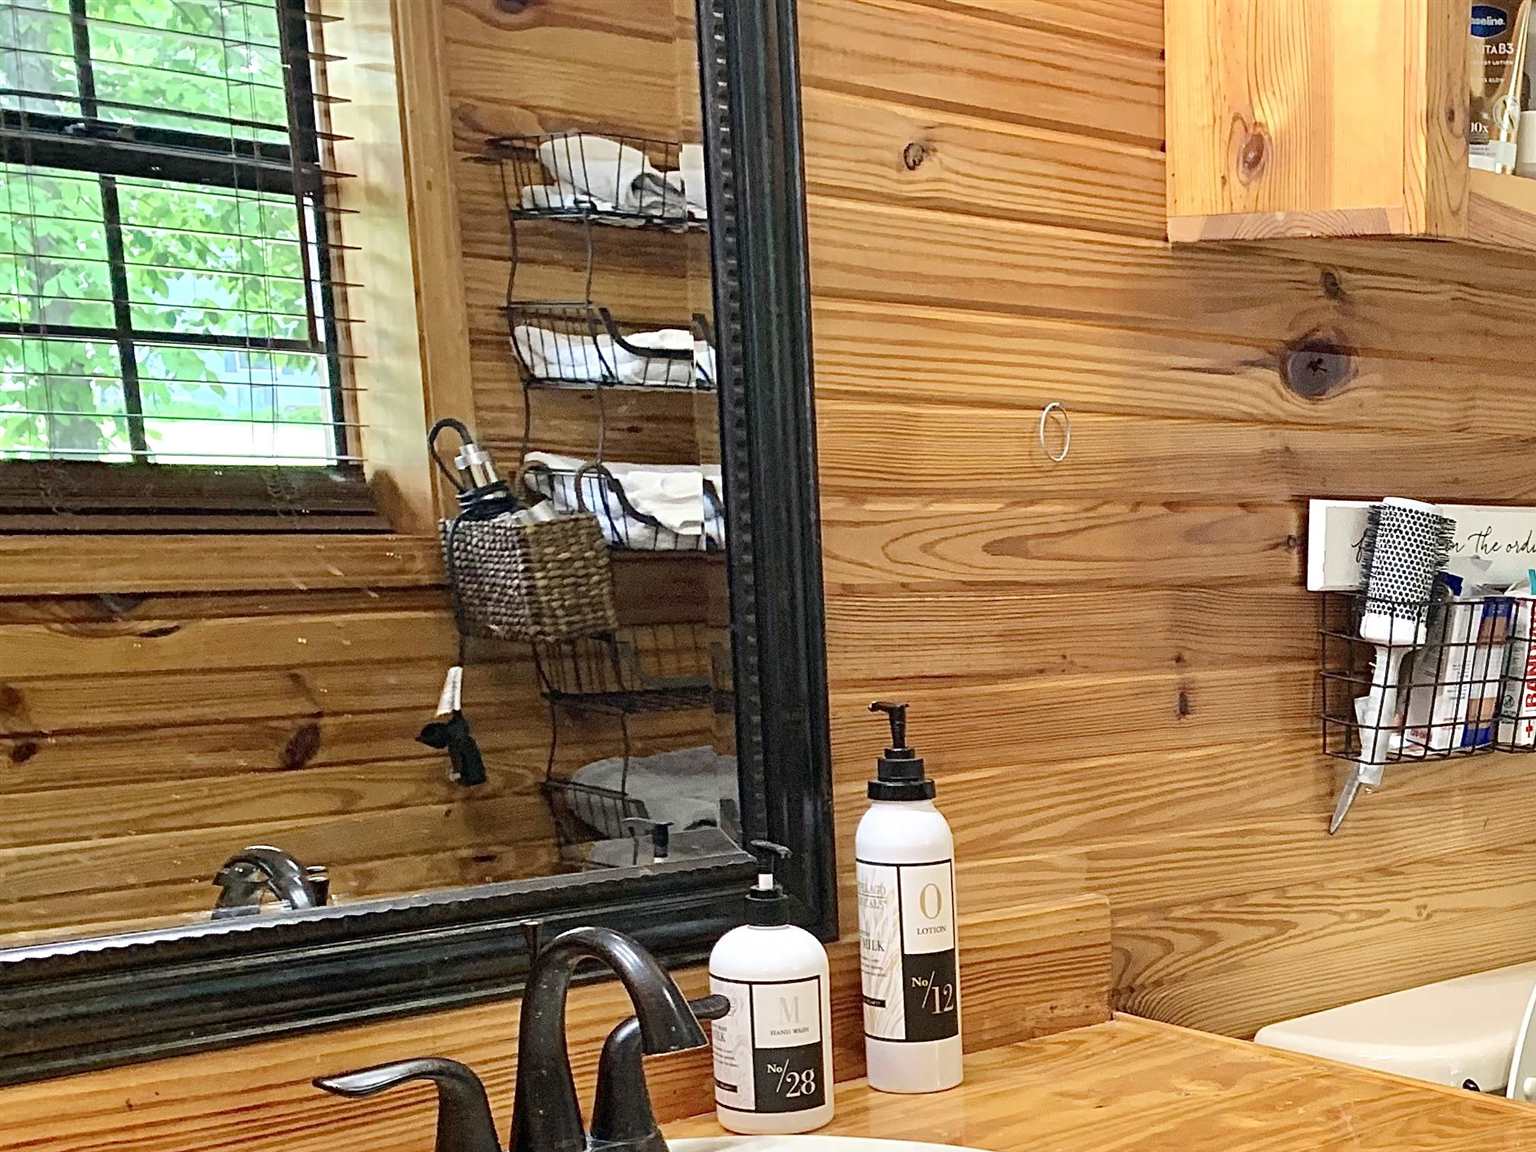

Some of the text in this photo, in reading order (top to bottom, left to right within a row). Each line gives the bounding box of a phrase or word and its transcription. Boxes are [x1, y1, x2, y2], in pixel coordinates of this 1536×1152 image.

[919, 883, 942, 919] O
[916, 926, 947, 936] LOTION
[770, 1028, 792, 1037] HAND
